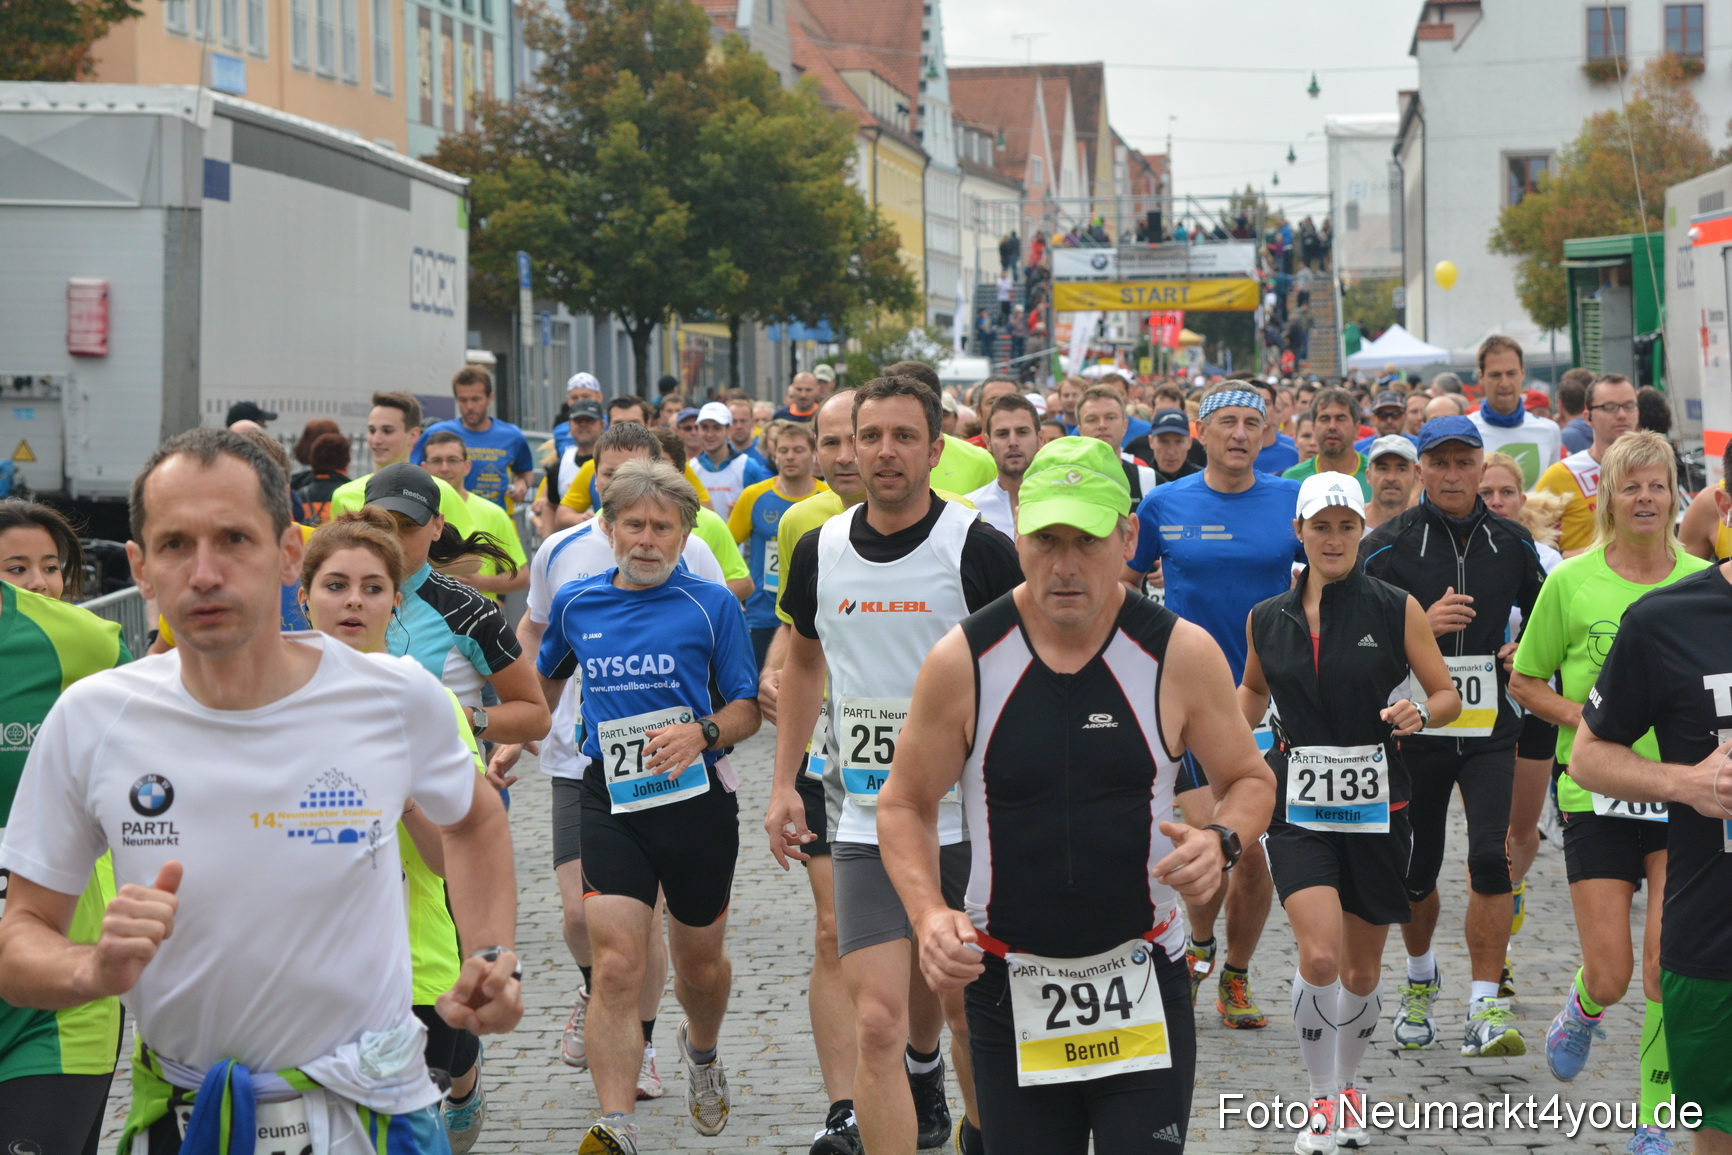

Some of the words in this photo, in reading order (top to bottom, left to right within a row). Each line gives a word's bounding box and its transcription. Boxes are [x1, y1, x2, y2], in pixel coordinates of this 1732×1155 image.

[410, 246, 457, 317] BOCK
[1121, 286, 1191, 304] START
[403, 488, 428, 505] Reebok
[861, 601, 932, 613] KLEBL
[588, 632, 602, 640] JAKO
[586, 653, 676, 679] SYSCAD
[1446, 664, 1482, 672] eumarkt
[589, 680, 681, 693] www.metallbau-cad.de
[843, 707, 877, 719] PARTL
[600, 728, 628, 740] PARTL
[629, 717, 676, 735] Neumarkt
[851, 724, 901, 764] 25
[1291, 755, 1322, 764] PARTL
[1324, 755, 1369, 764] Neumarkt
[632, 778, 680, 798] Johann
[1298, 767, 1379, 802] 2133
[249, 812, 283, 829] 14.
[278, 810, 339, 819] Neumarkter
[342, 809, 383, 817] Stadtlauf
[1315, 808, 1361, 821] Kerstin
[122, 821, 180, 835] PARTL
[122, 836, 179, 847] Neumarkt
[1059, 956, 1127, 978] Neumarkt
[1041, 975, 1133, 1031] 294
[1021, 1031, 1028, 1041] C
[1064, 1036, 1120, 1062] Bernd
[1152, 1130, 1182, 1145] adidas
